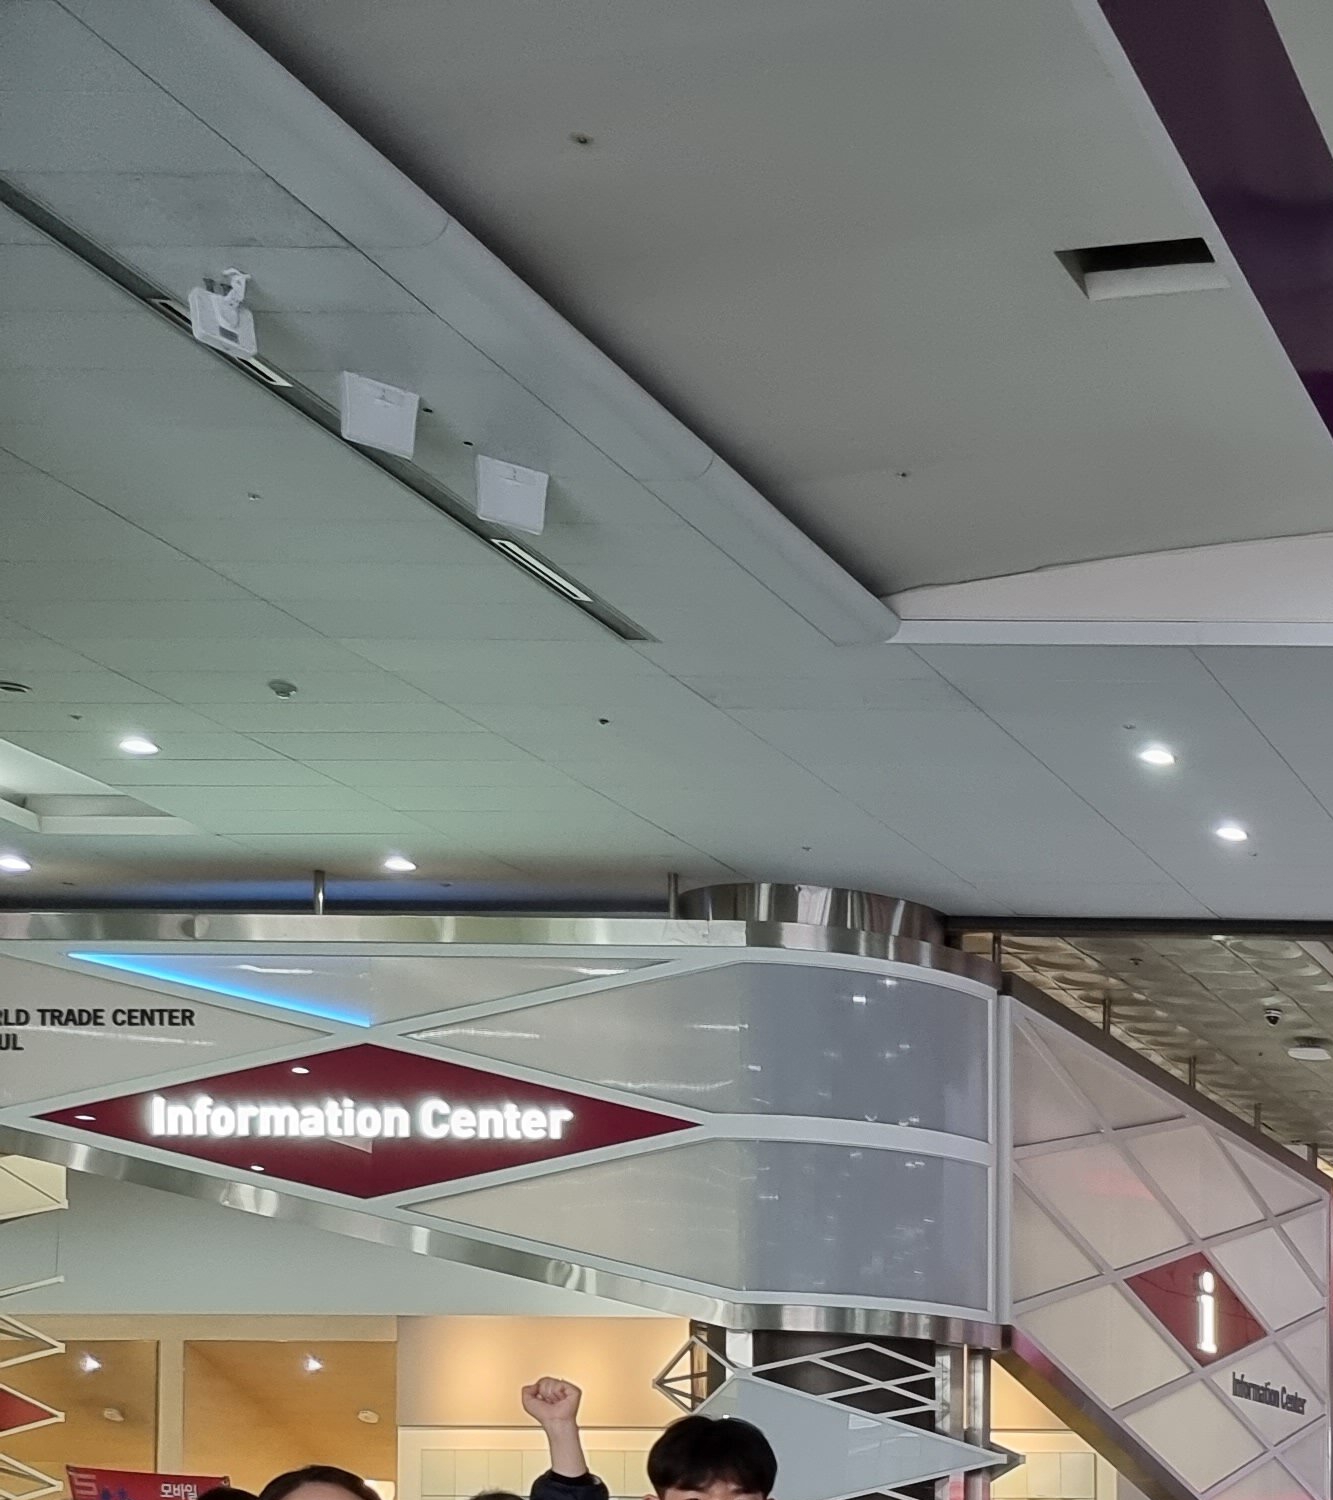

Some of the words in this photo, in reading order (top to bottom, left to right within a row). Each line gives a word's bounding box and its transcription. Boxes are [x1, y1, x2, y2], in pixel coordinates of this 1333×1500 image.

[0, 1008, 31, 1027] LD
[37, 1008, 106, 1027] TRADE
[112, 1008, 196, 1027] CENTER
[149, 1094, 412, 1139] Information
[418, 1096, 576, 1141] Center
[160, 1483, 199, 1500] 모바일
